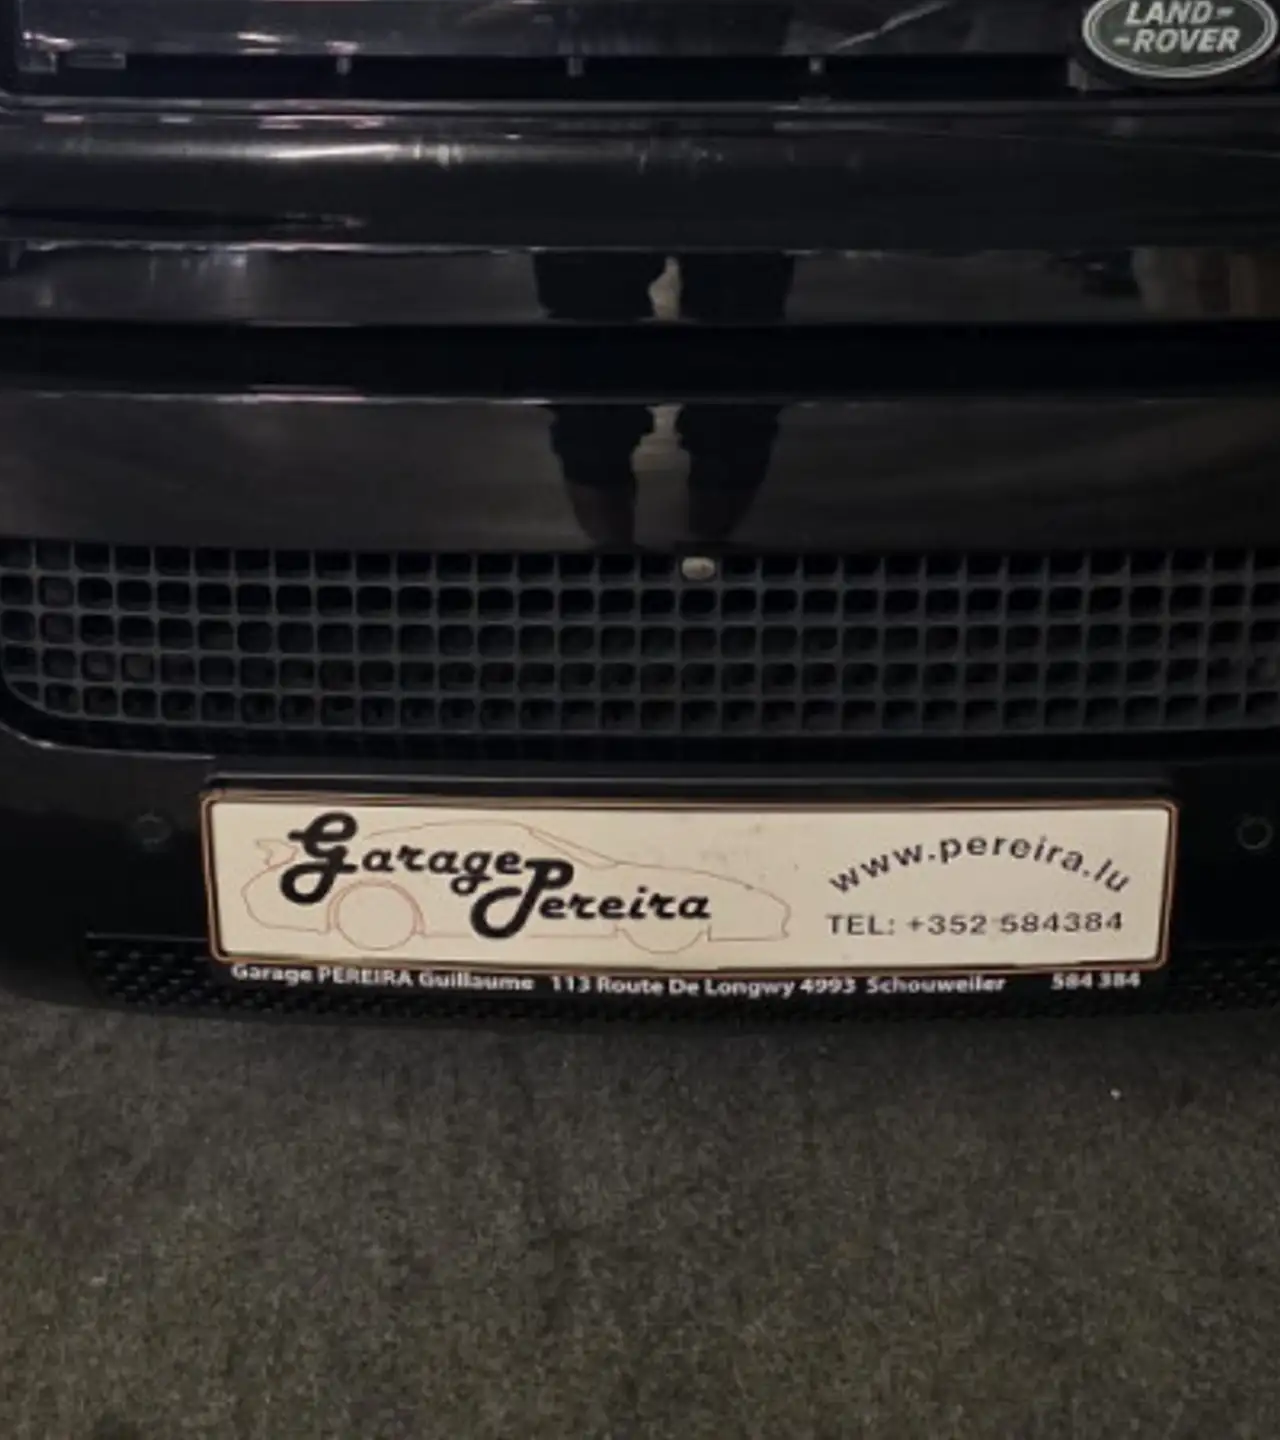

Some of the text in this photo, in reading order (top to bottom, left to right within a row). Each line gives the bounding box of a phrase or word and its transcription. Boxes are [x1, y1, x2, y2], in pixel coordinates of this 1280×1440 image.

[280, 812, 524, 906] Garage
[828, 834, 1132, 895] www.pereira.lu
[470, 858, 712, 940] Pereira
[826, 911, 1124, 937] TEL: +352 584384
[230, 962, 1141, 999] Garage PEREIRA Guillaume 113 Route De Longwy 4993 Schouweiler 584 384
